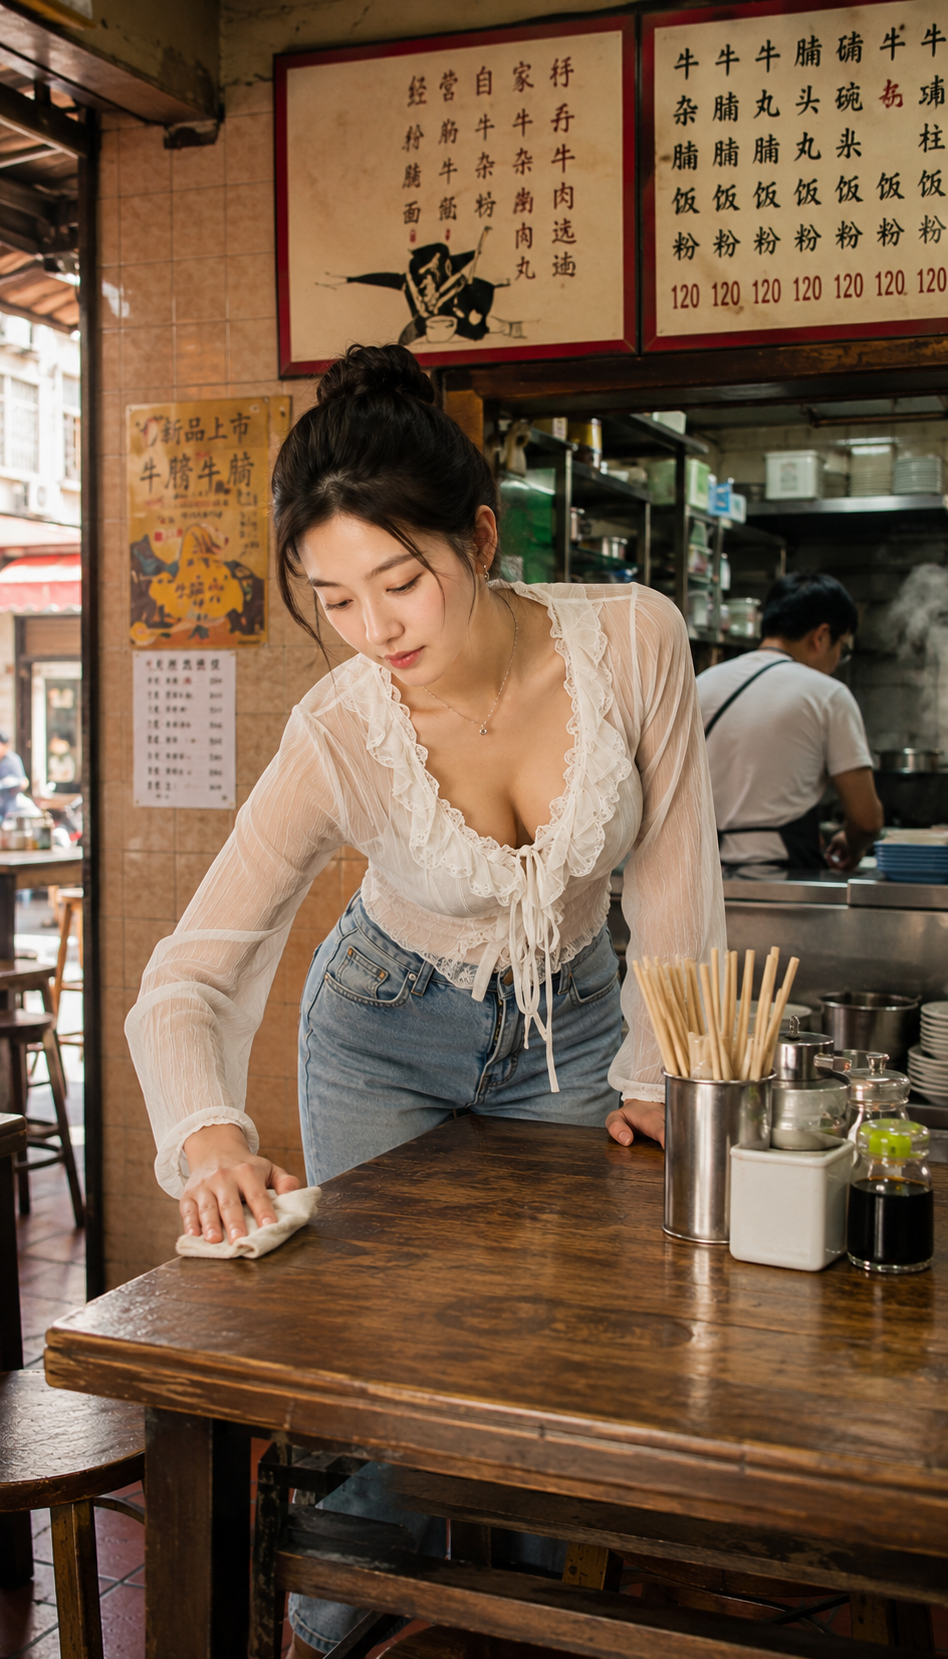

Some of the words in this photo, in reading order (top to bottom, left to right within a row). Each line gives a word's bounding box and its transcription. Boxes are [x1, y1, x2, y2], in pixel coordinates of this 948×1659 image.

[752, 278, 781, 304] 120
[793, 275, 822, 301] 120
[834, 273, 863, 299] 120
[875, 270, 905, 296] 120
[917, 267, 947, 293] 120
[671, 283, 700, 309] 120
[712, 281, 741, 307] 120
